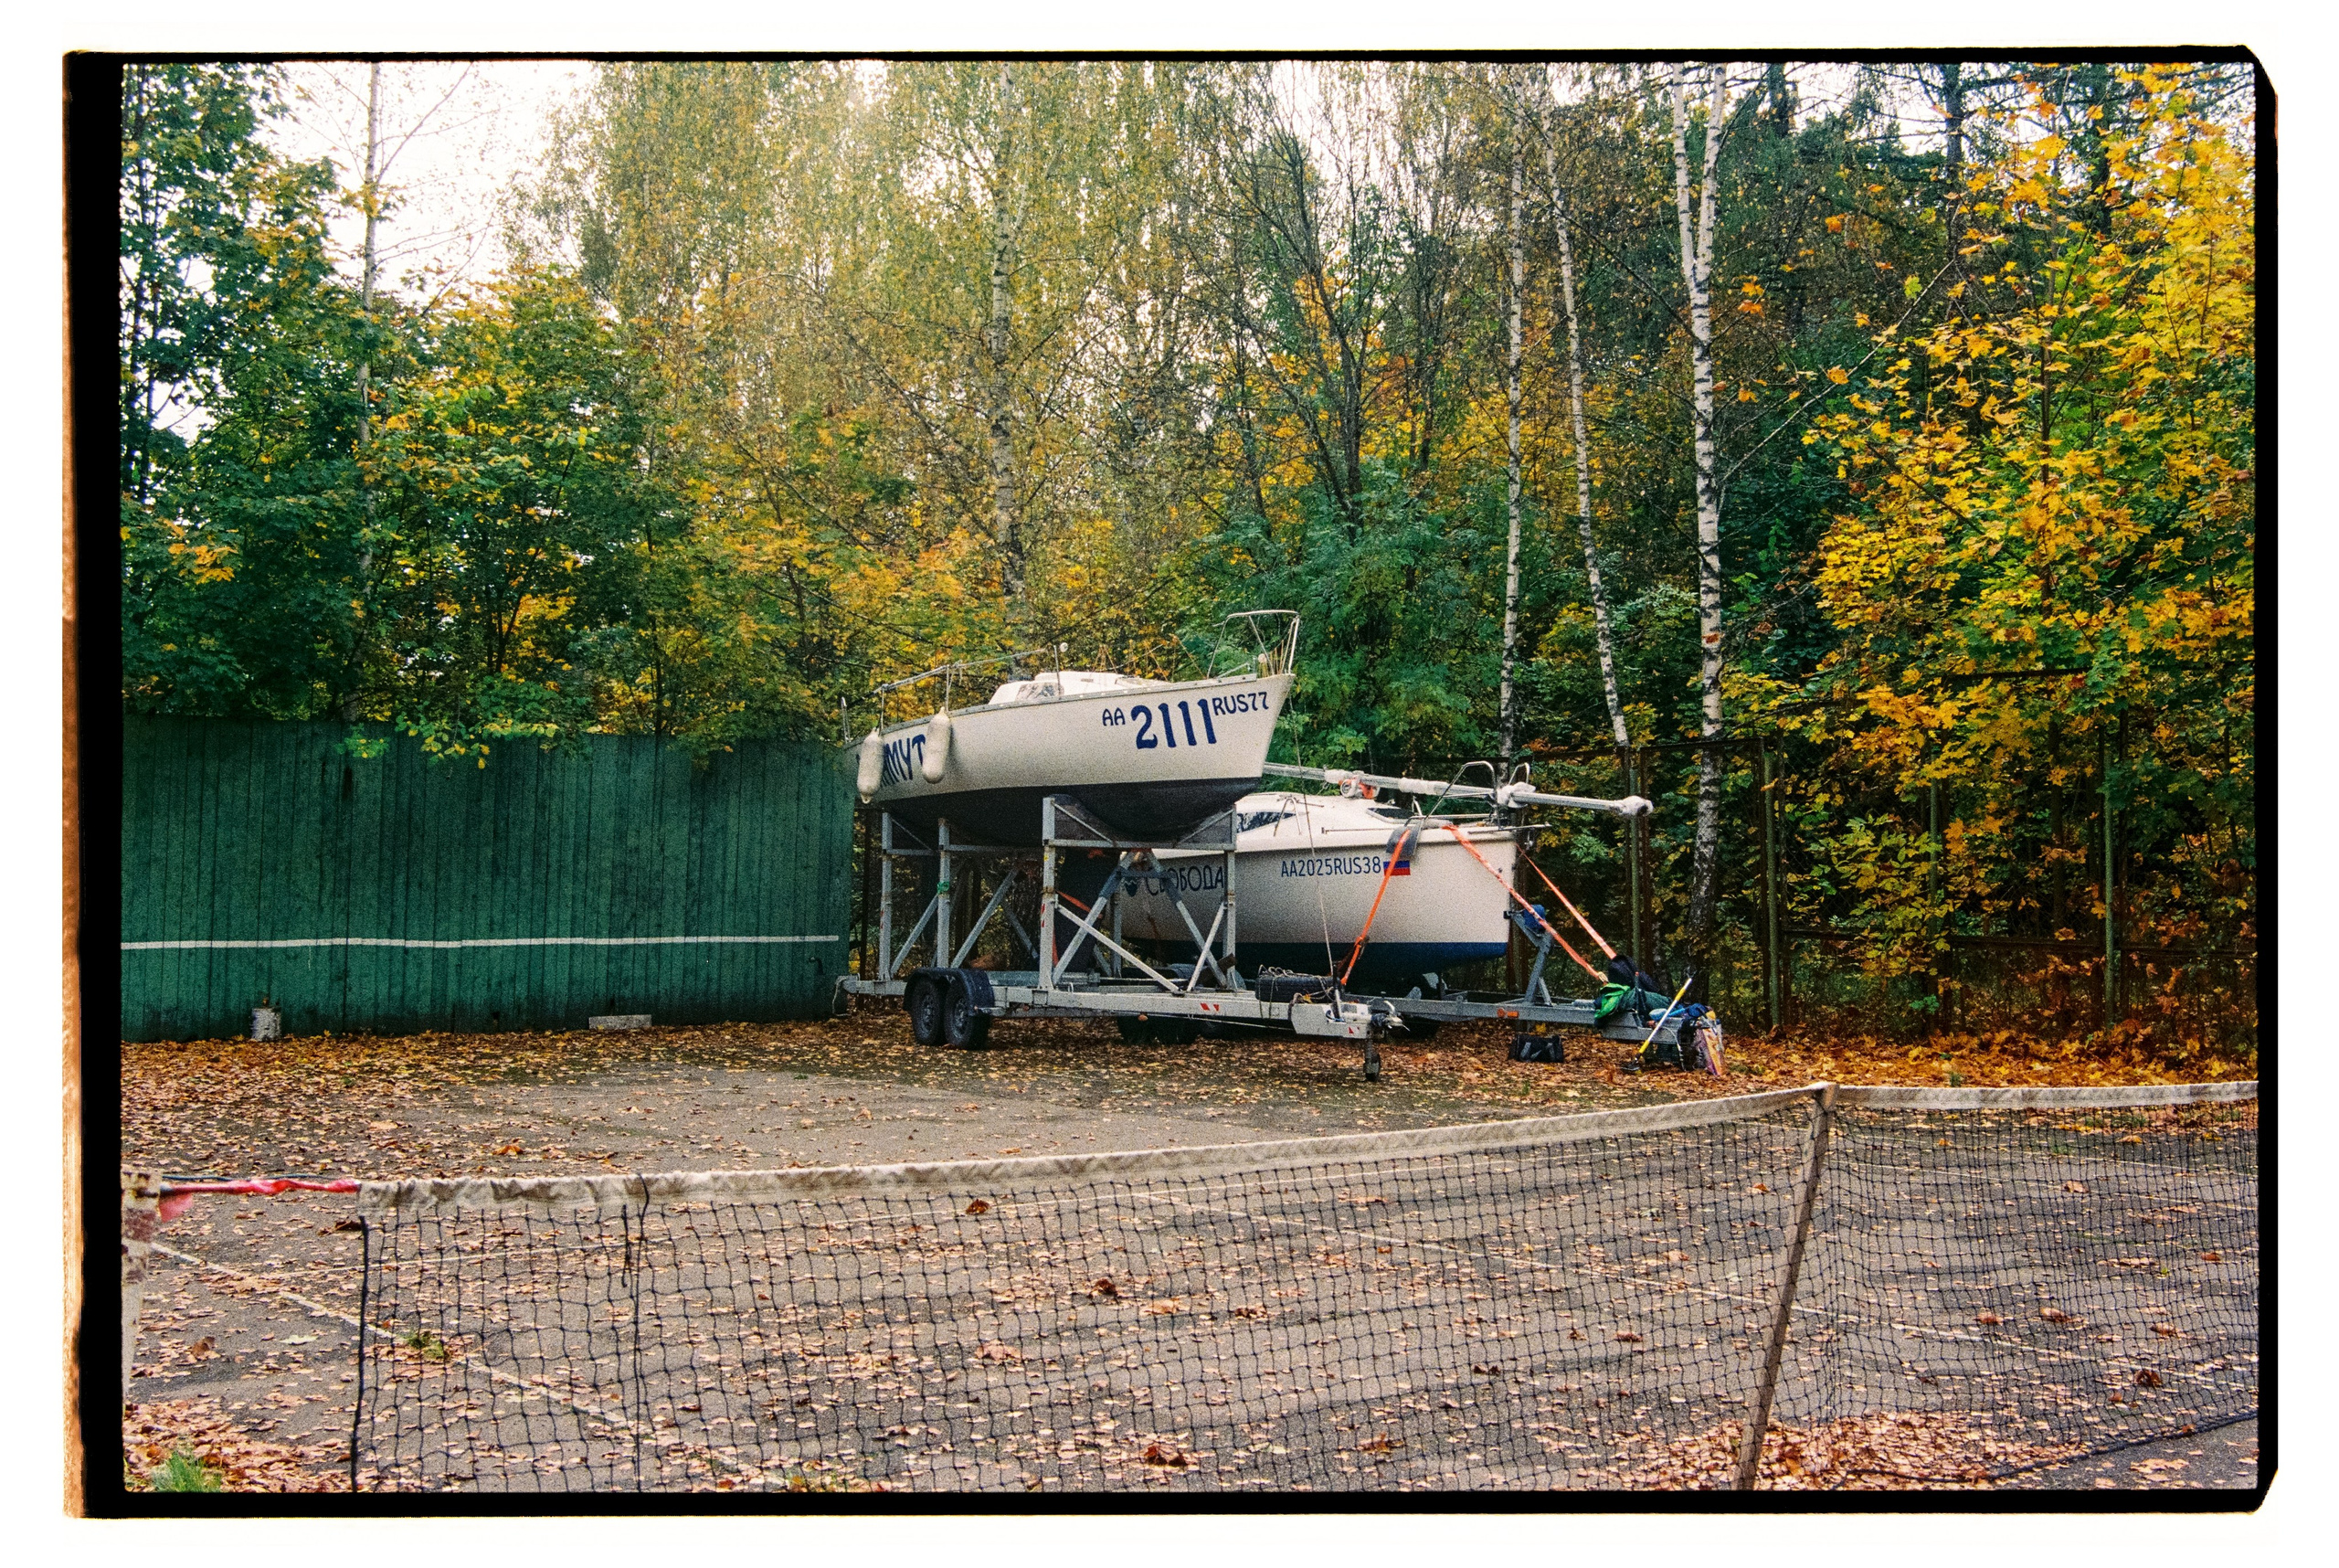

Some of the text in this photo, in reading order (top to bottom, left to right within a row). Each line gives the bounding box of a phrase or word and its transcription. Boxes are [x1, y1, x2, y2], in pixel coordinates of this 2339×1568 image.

[1102, 692, 1269, 749] AA 2111 RUS77
[1281, 856, 1381, 877] AA2025RUS38
